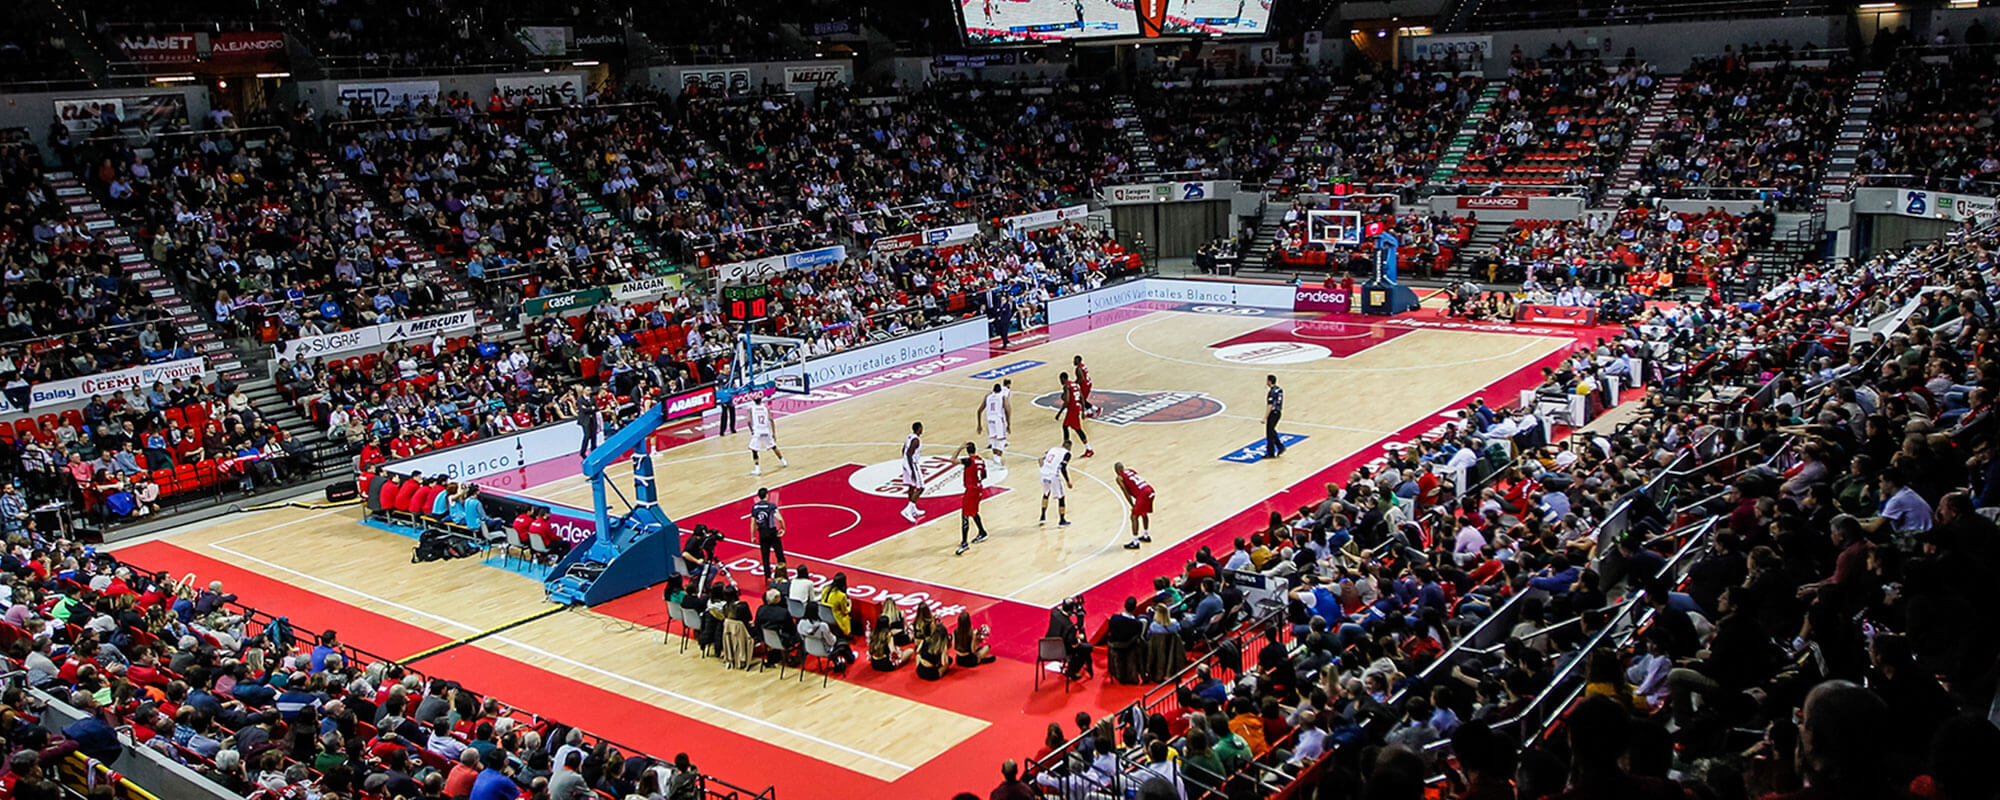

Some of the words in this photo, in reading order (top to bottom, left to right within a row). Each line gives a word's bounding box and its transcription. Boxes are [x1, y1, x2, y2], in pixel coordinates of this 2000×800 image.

[213, 39, 284, 52] ALEJANDRO
[1467, 198, 1519, 206] ALEJANDRO
[621, 278, 664, 293] ANAGAN
[548, 295, 576, 308] caser
[1187, 288, 1227, 302] Blanco
[1296, 291, 1345, 303] endesa
[732, 301, 746, 319] 10
[752, 298, 766, 317] 10
[410, 313, 467, 332] MERCURY
[312, 332, 361, 352] SUGRAF
[808, 366, 836, 383] MOS
[840, 353, 897, 376] Varietales
[901, 343, 936, 361] Blanco
[165, 365, 201, 379] VOLUM
[97, 375, 140, 391] CEMU
[33, 388, 76, 402] Balay
[668, 392, 714, 414] ARABET
[448, 455, 510, 480] Blanco
